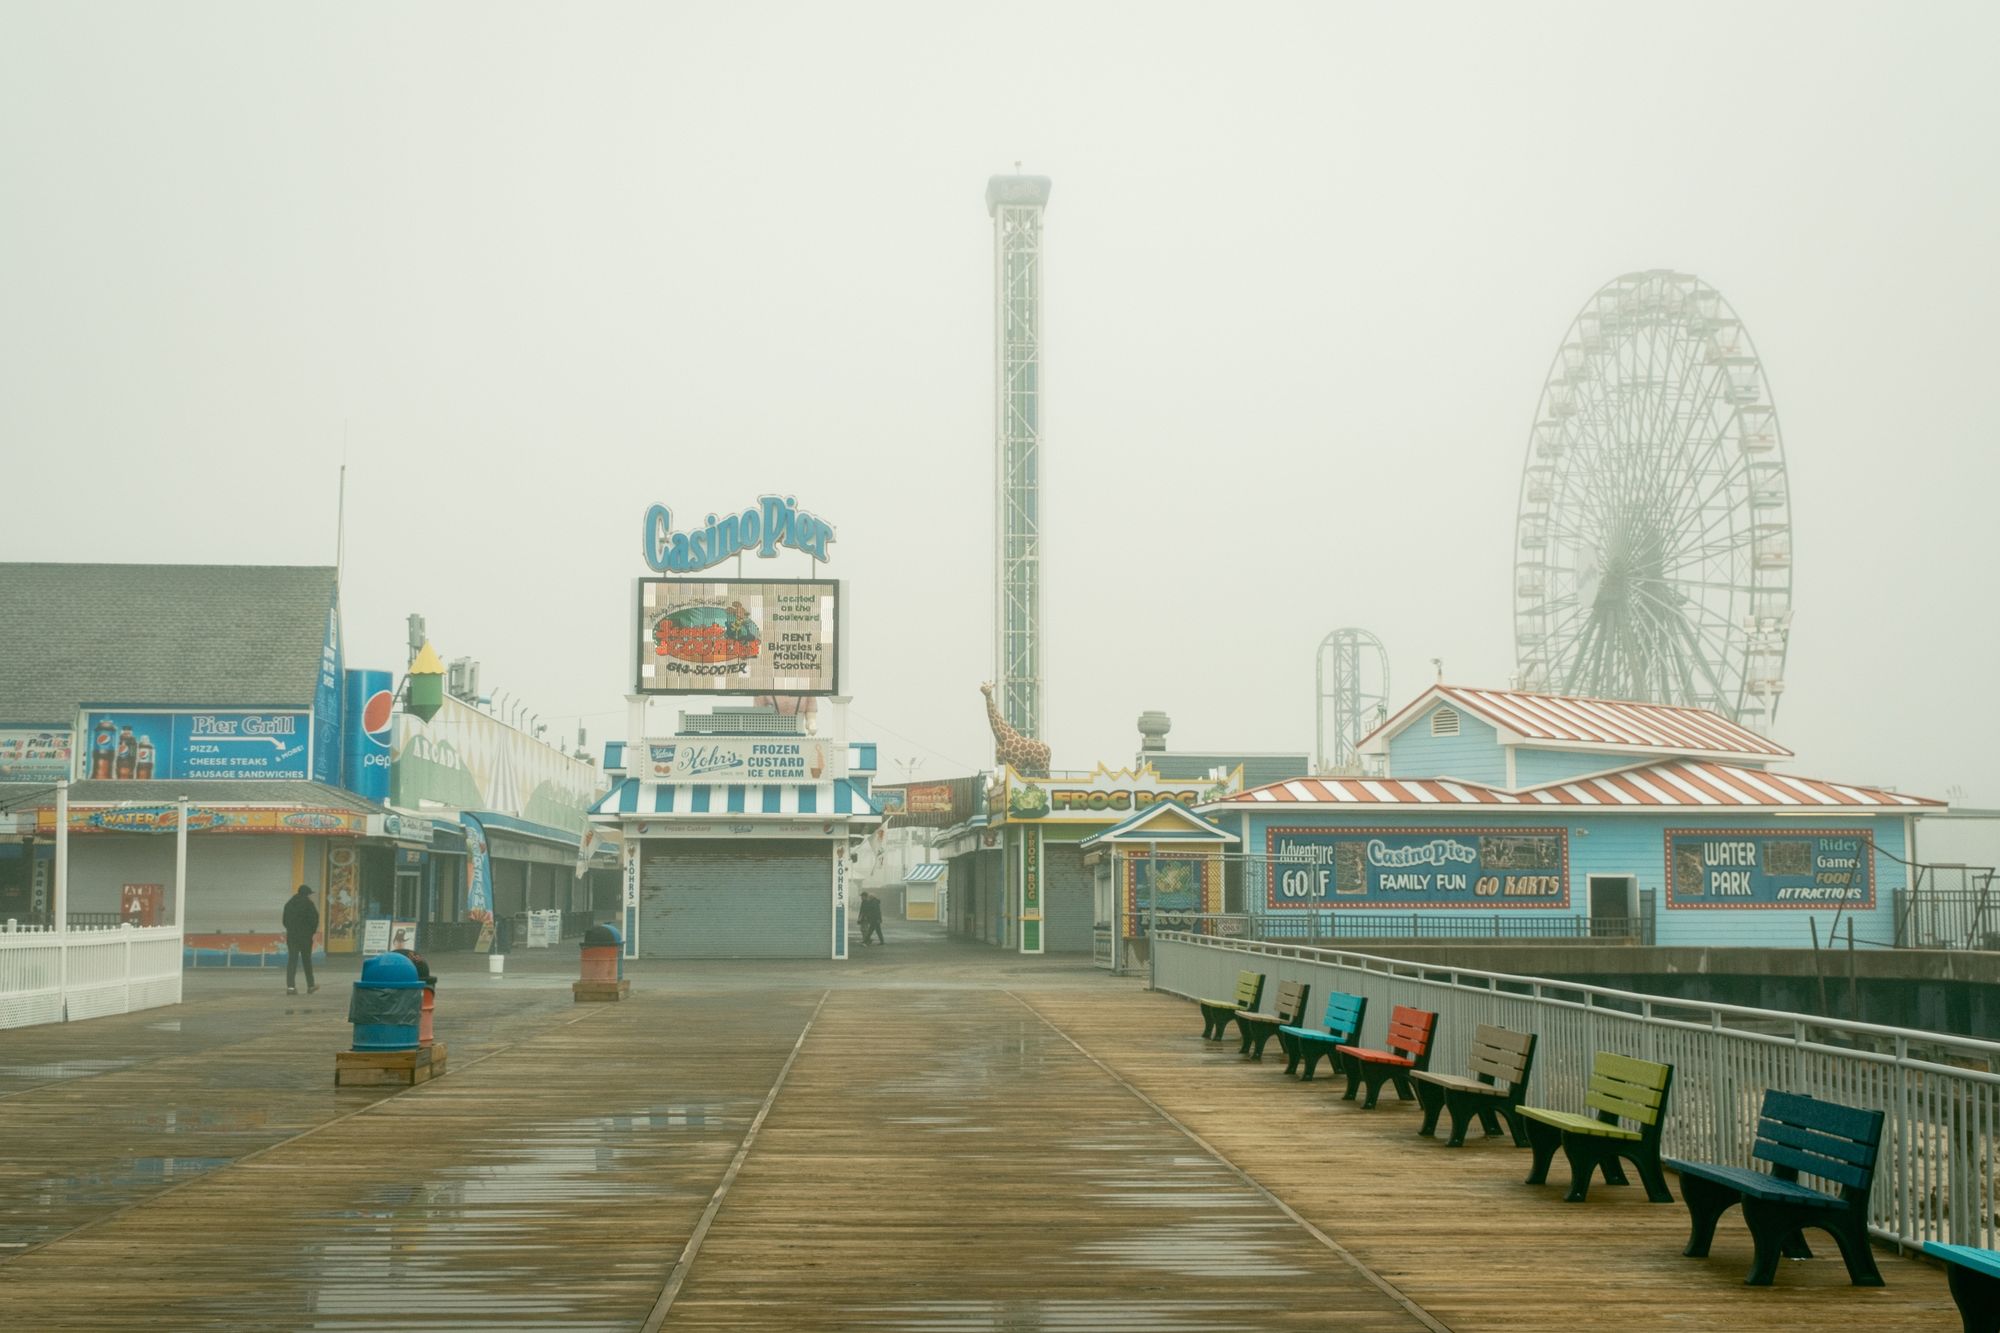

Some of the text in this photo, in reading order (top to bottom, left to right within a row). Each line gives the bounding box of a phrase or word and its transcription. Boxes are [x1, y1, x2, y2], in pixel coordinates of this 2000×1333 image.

[643, 494, 836, 573] Casino Pier
[777, 595, 816, 603] Located
[795, 603, 812, 612] the
[772, 613, 820, 622] Boulevard
[781, 633, 813, 642] RENT
[768, 642, 823, 652] Bicycles &
[773, 652, 818, 662] Mobility
[773, 661, 822, 671] Scooters
[191, 716, 296, 735] Pier Grill
[27, 738, 68, 748] Parties
[189, 745, 220, 753] PIZZA
[752, 744, 800, 755] FROZEN
[280, 744, 305, 760] MORE!
[677, 745, 737, 771] Kohr's
[189, 758, 268, 766] CHEESE STEAKS
[748, 757, 805, 768] CUSTARD
[189, 770, 304, 778] SAUSAGE SANDWICHES
[747, 769, 766, 777] ICE
[768, 769, 804, 777] CREAM
[1051, 790, 1132, 811] FROG
[103, 813, 155, 824] WATER
[1028, 830, 1036, 865] FROG
[1279, 839, 1334, 865] Adventure
[1819, 839, 1858, 852] Rides
[1367, 839, 1477, 867] Casino Pier
[1704, 842, 1756, 867] WATER
[1817, 856, 1861, 869] Games
[627, 859, 635, 900] KOHRS
[1282, 870, 1331, 897] GOLF
[1380, 874, 1467, 891] FAMILY FUN
[1711, 871, 1752, 896] PARK
[1816, 872, 1852, 885] FOOD
[1028, 873, 1036, 900] BOG
[1475, 876, 1560, 897] GO KARTS
[1777, 887, 1862, 900] ATTRACTIONS
